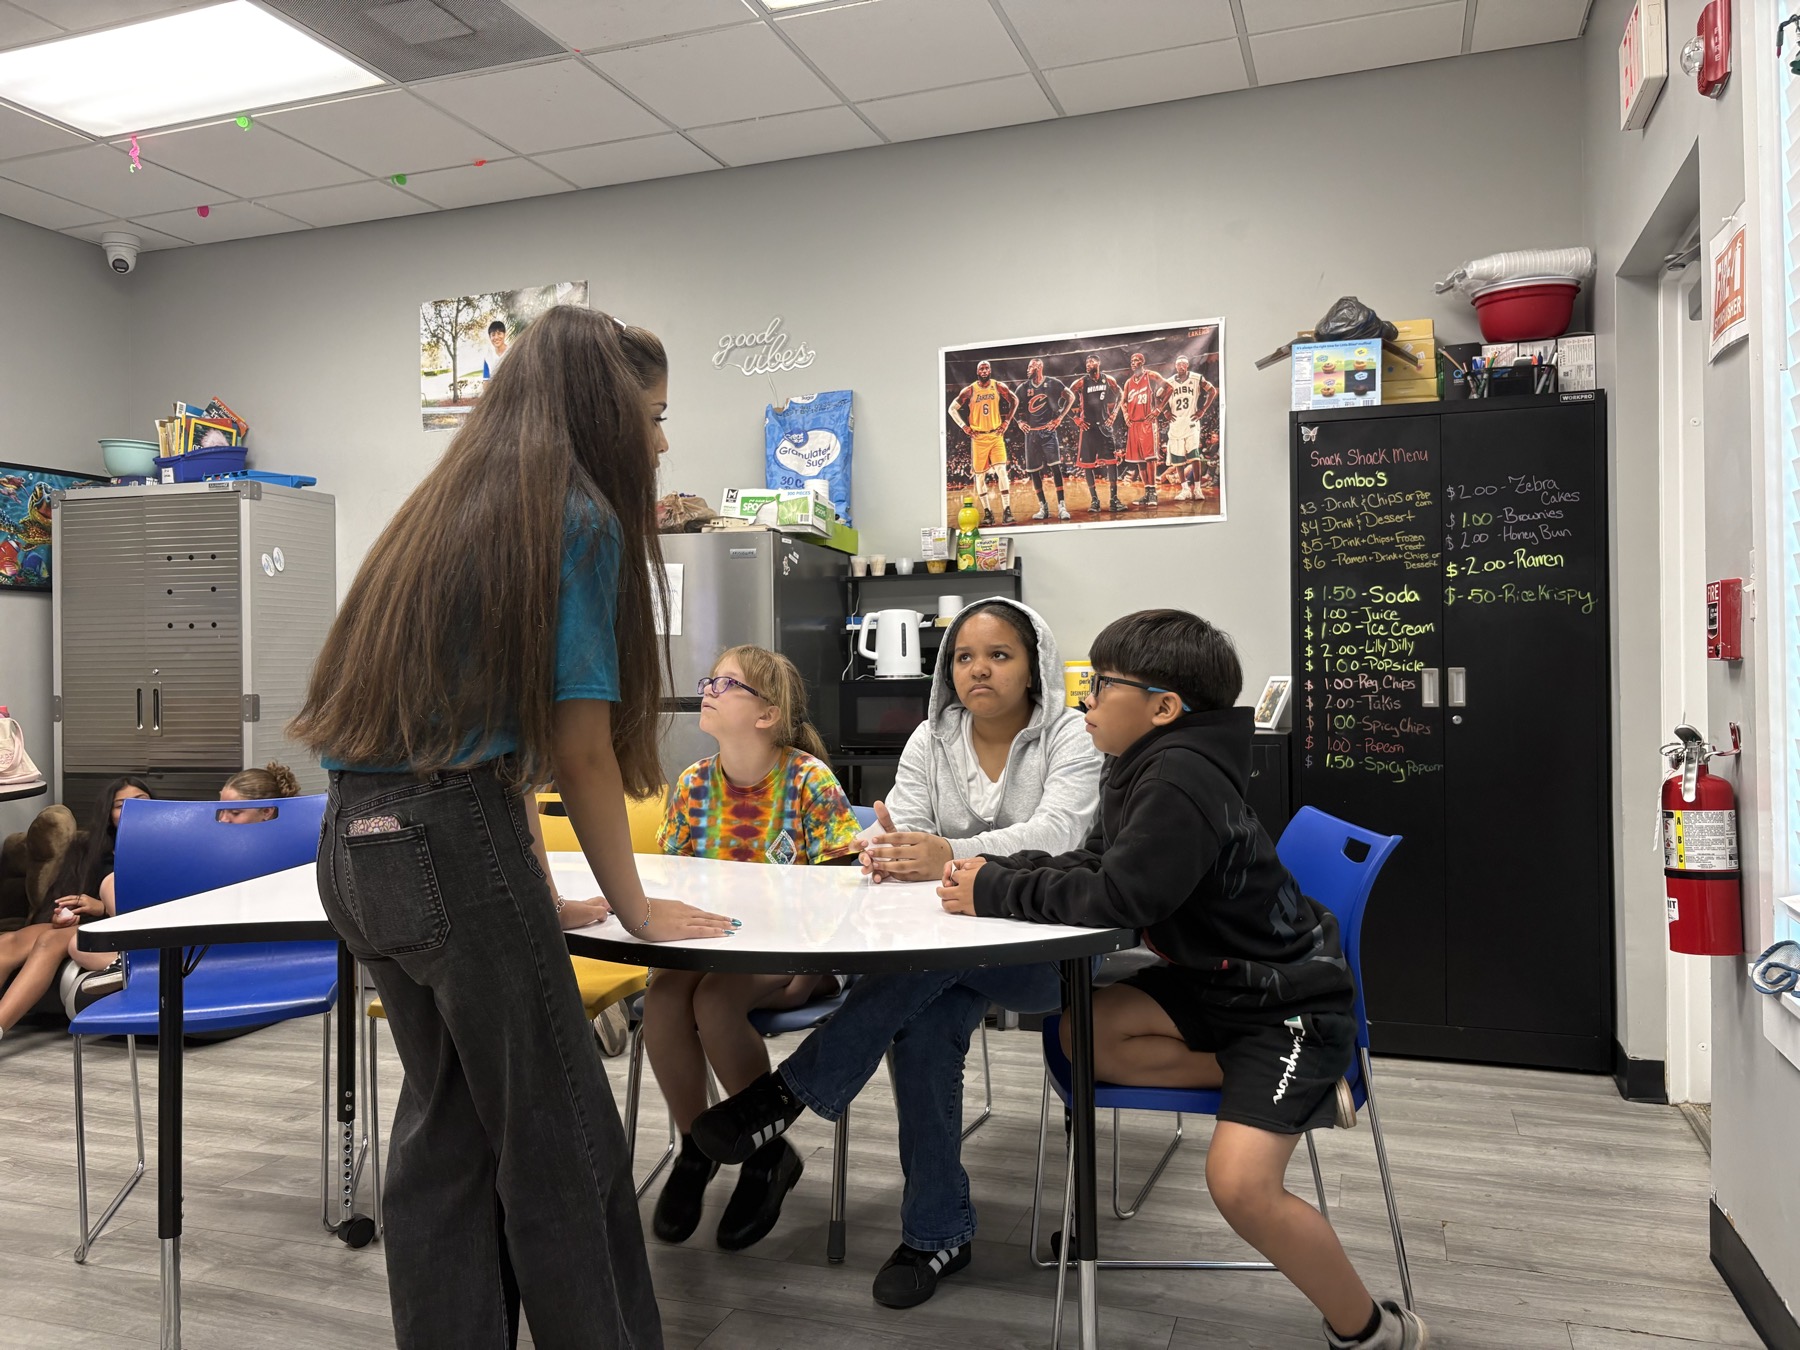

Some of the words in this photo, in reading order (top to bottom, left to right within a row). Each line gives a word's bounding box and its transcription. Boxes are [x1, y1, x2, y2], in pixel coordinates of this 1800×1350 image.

[711, 317, 781, 367] good
[743, 333, 816, 375] vibes
[1100, 391, 1105, 400] 6
[1137, 393, 1147, 405] 23
[1174, 386, 1194, 397] RISH
[983, 403, 989, 415] 6
[1176, 397, 1189, 411] 23
[1311, 451, 1342, 467] Snack
[1347, 448, 1390, 466] Shack
[1393, 448, 1428, 463] Menu
[780, 476, 794, 486] 30
[1300, 502, 1317, 515] $3
[1405, 493, 1415, 502] or
[1541, 491, 1580, 505] Cakes
[1301, 520, 1319, 536] $4
[1360, 510, 1415, 528] Dessert
[1302, 538, 1323, 554] $5
[1302, 554, 1326, 572] $6
[1323, 586, 1356, 601] 1.50
[1707, 584, 1719, 602] FIRE
[1323, 607, 1347, 619] 1.00
[1391, 622, 1435, 636] Cream
[1320, 644, 1357, 657] 2.00
[1388, 637, 1414, 656] Dilly
[1383, 674, 1416, 691] Chips
[1400, 717, 1431, 735] Chips
[1326, 753, 1354, 769] 1.50
[1677, 817, 1681, 825] A
[1678, 836, 1682, 844] B
[1678, 855, 1683, 863] C
